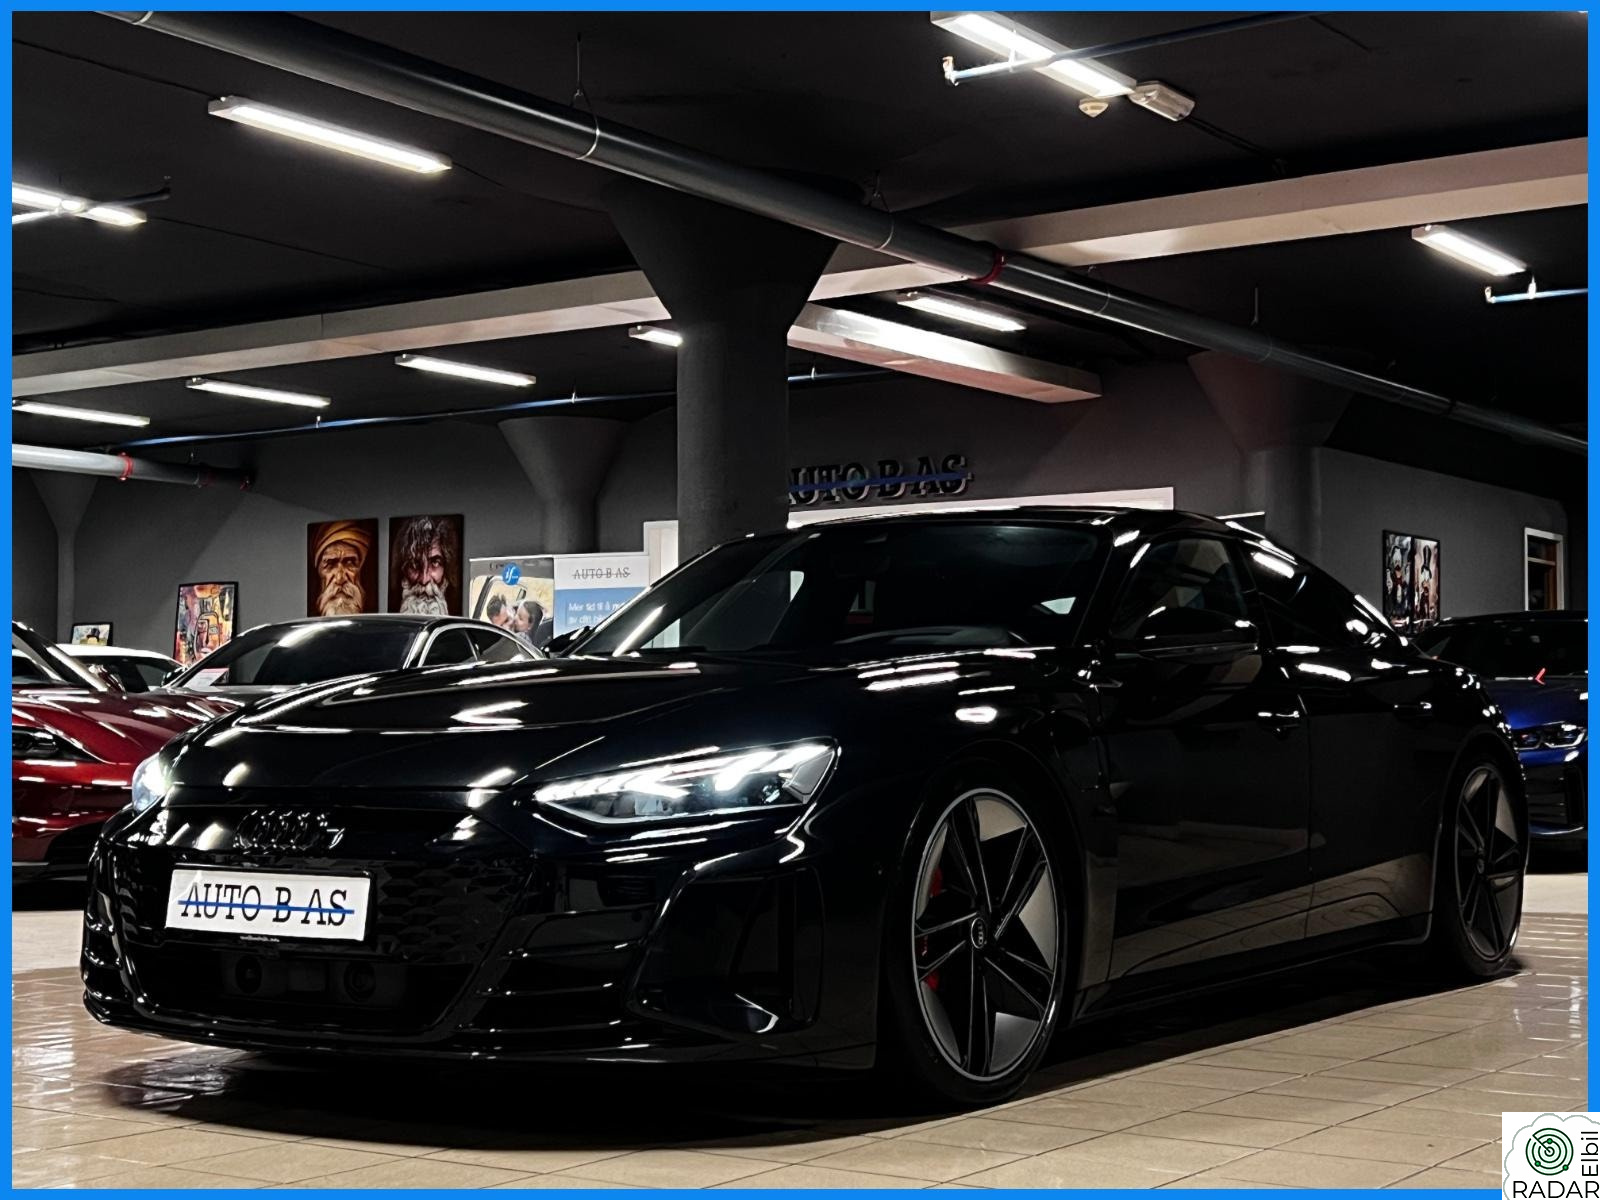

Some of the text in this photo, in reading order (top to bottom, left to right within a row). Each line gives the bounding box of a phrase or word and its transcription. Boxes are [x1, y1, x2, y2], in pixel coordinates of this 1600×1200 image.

[788, 453, 974, 505] UTO B AS
[573, 567, 630, 580] AUTO B AS
[180, 881, 348, 927] AUTO B AS
